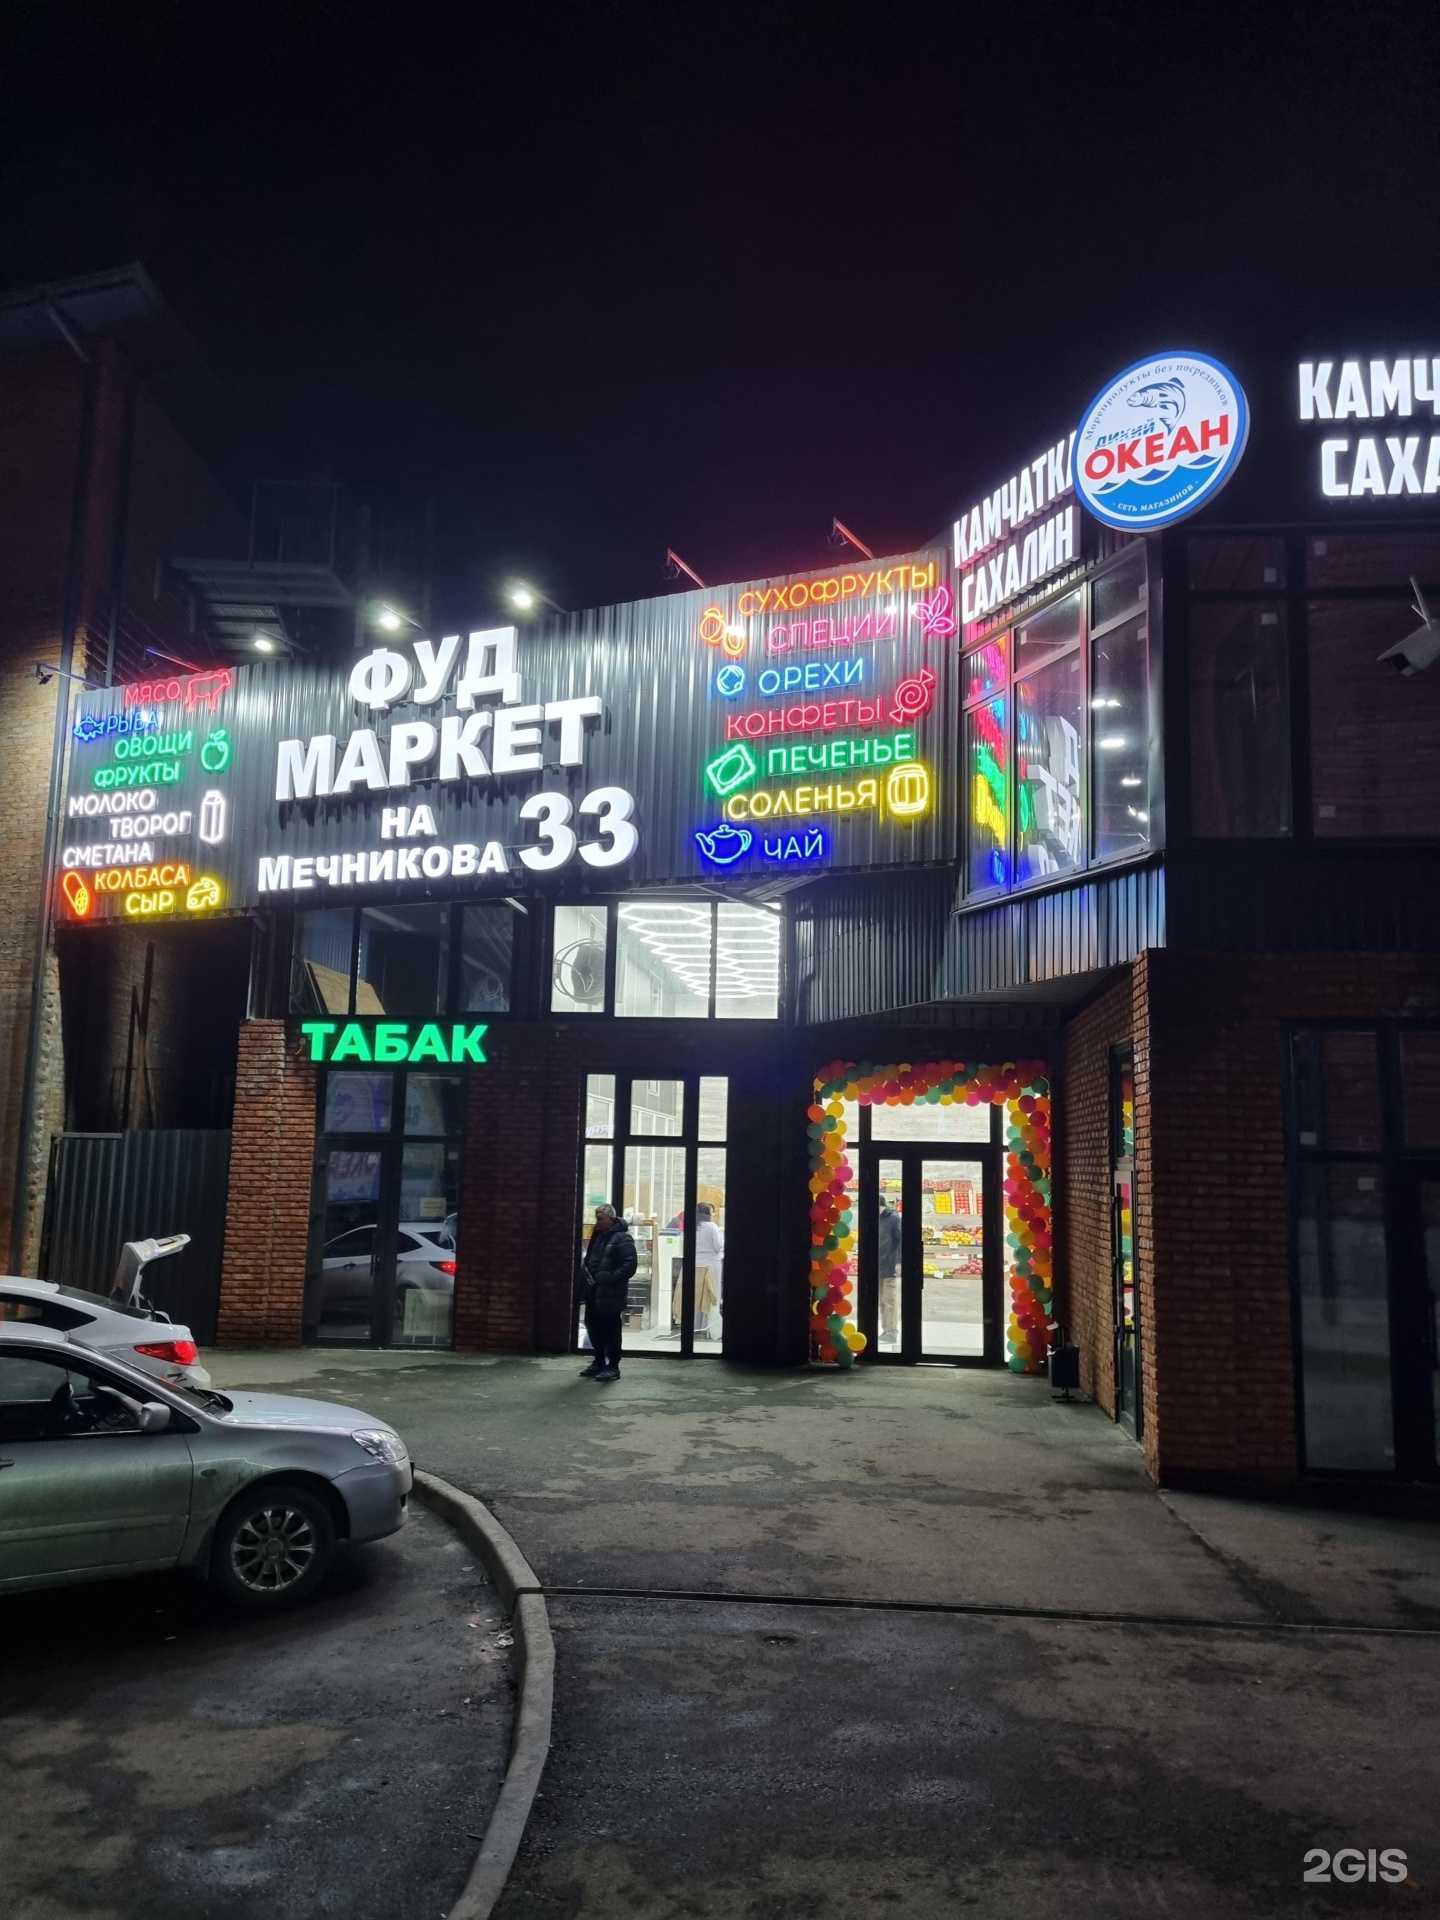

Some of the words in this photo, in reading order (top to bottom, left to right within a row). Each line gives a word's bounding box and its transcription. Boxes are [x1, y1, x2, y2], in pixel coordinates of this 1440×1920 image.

[1084, 414, 1230, 481] ОКЕАН
[961, 505, 1074, 625] САХАЛИН
[738, 562, 935, 617] СУХОФРУКТЫ
[768, 613, 895, 651] СПЕЦИИ
[349, 625, 522, 711] ФУД
[758, 657, 865, 695] ОРЕХИ
[124, 682, 181, 705] МЯСО
[106, 711, 161, 733] РЫБА
[726, 697, 881, 739] КОНФЕТЫ
[114, 731, 193, 759] ОВОЩИ
[275, 696, 603, 801] МАРКЕТ
[767, 733, 914, 775] ПЕЧЕНЬЕ
[94, 763, 182, 787] ФРУКТЫ
[69, 790, 157, 816] МОЛОКО
[726, 779, 877, 820] СОЛЕНЬЯ
[110, 812, 193, 838] ТВОРОГ
[381, 804, 438, 839] НА
[518, 787, 640, 871] 33
[63, 844, 154, 868] СМЕТАНА
[763, 827, 824, 860] ЧАЙ
[94, 866, 188, 891] КОЛБАСА
[125, 892, 173, 914] СЫР
[301, 1023, 489, 1063] ТАБАК
